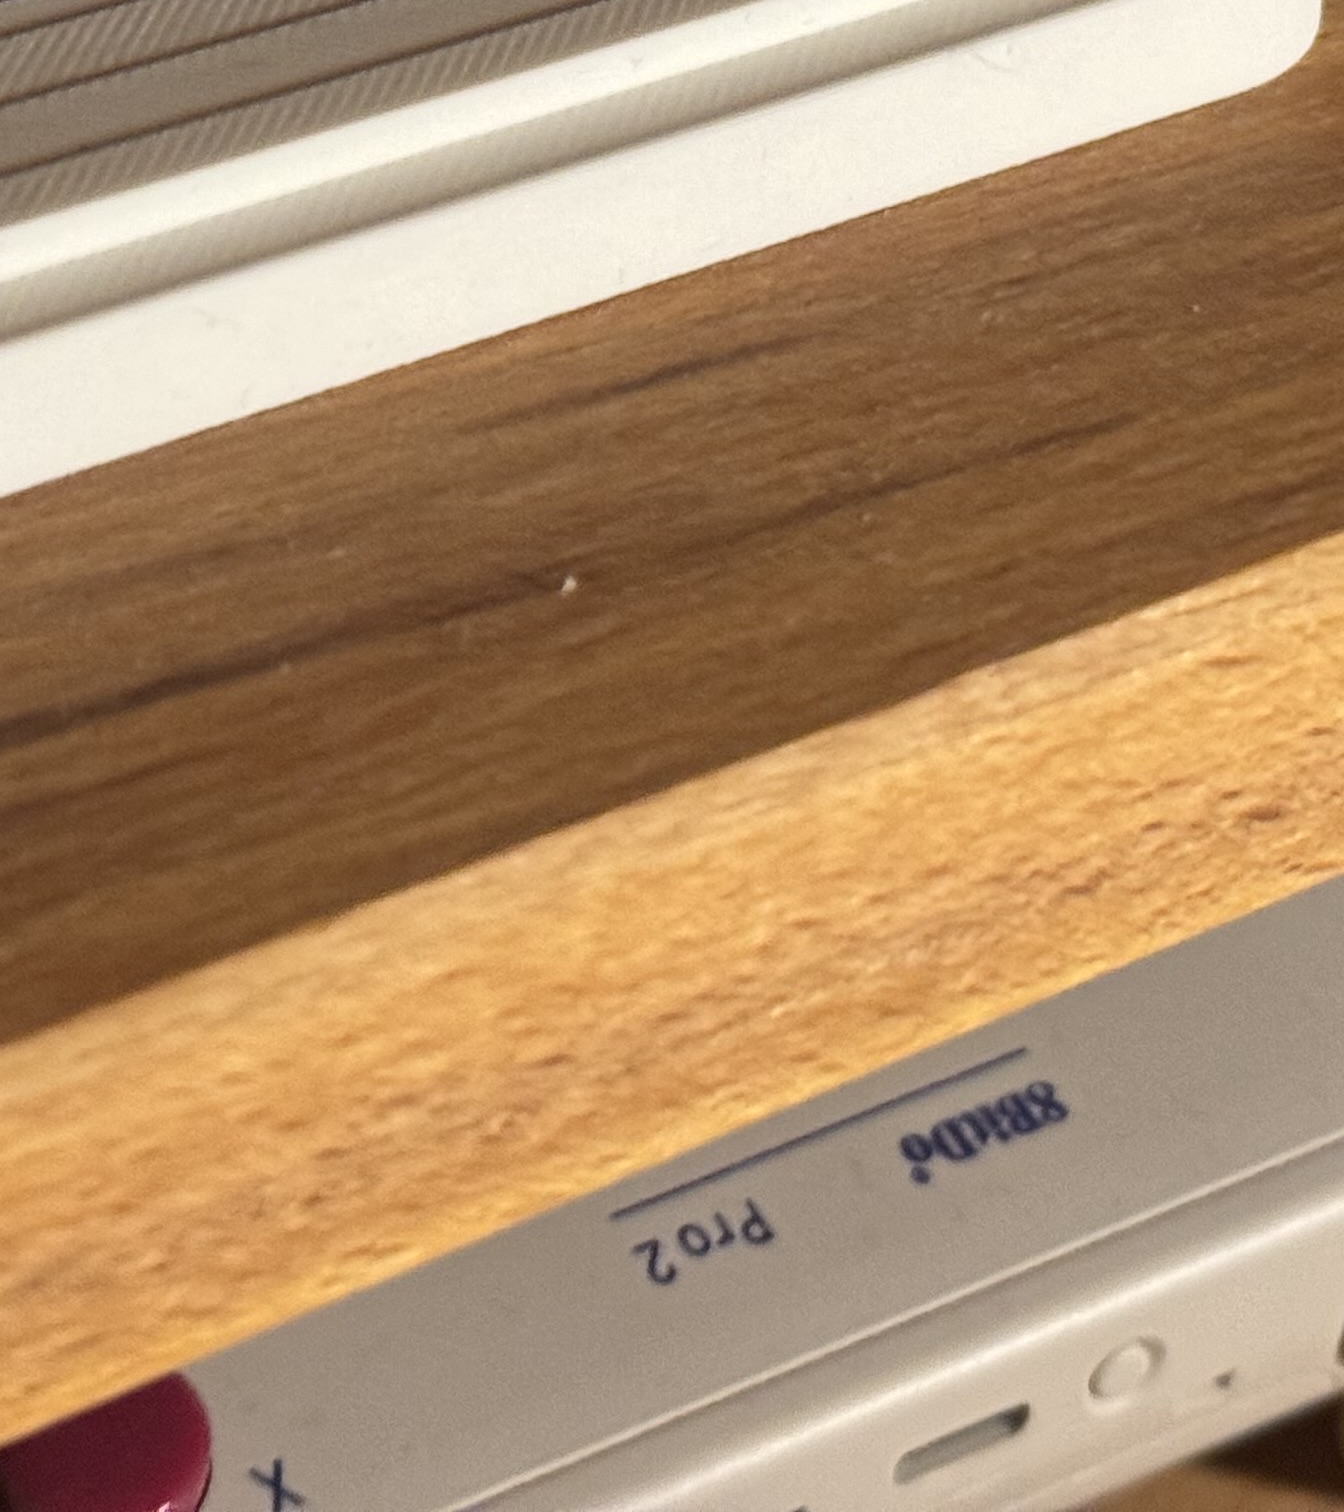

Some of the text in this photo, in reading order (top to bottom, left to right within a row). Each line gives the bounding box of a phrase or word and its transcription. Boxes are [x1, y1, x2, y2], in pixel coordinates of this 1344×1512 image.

[632, 1198, 775, 1285] Pro 2
[248, 1458, 305, 1512] X
